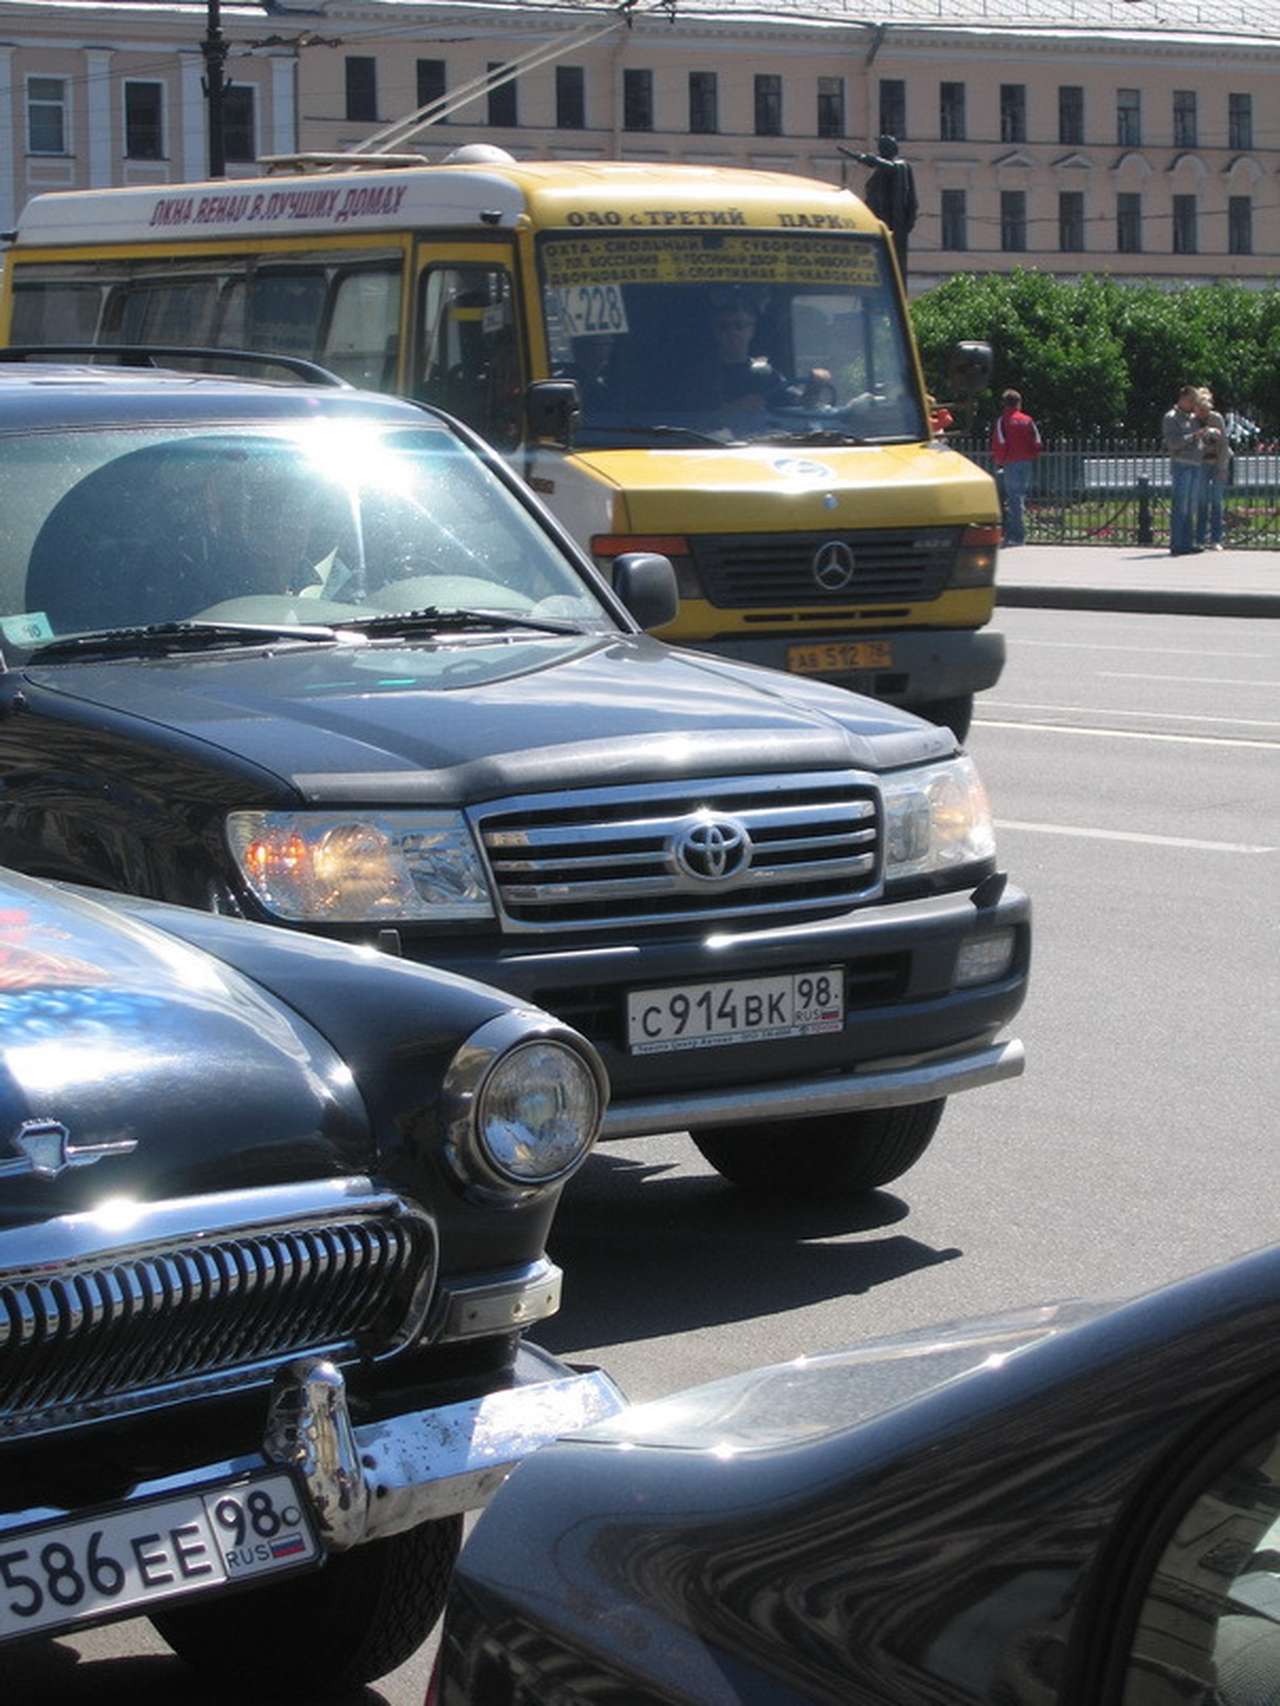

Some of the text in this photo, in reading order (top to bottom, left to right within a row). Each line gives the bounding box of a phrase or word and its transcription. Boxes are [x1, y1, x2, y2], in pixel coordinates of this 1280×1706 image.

[149, 198, 194, 226] ОКНА
[265, 190, 339, 221] ЛУЧШИХ
[334, 186, 408, 223] ДОМАХ
[567, 210, 622, 227] ОАО
[642, 976, 831, 1038] С914ВК 98
[796, 1009, 820, 1022] RUS
[215, 1490, 281, 1547] 98
[225, 1544, 271, 1570] RUS
